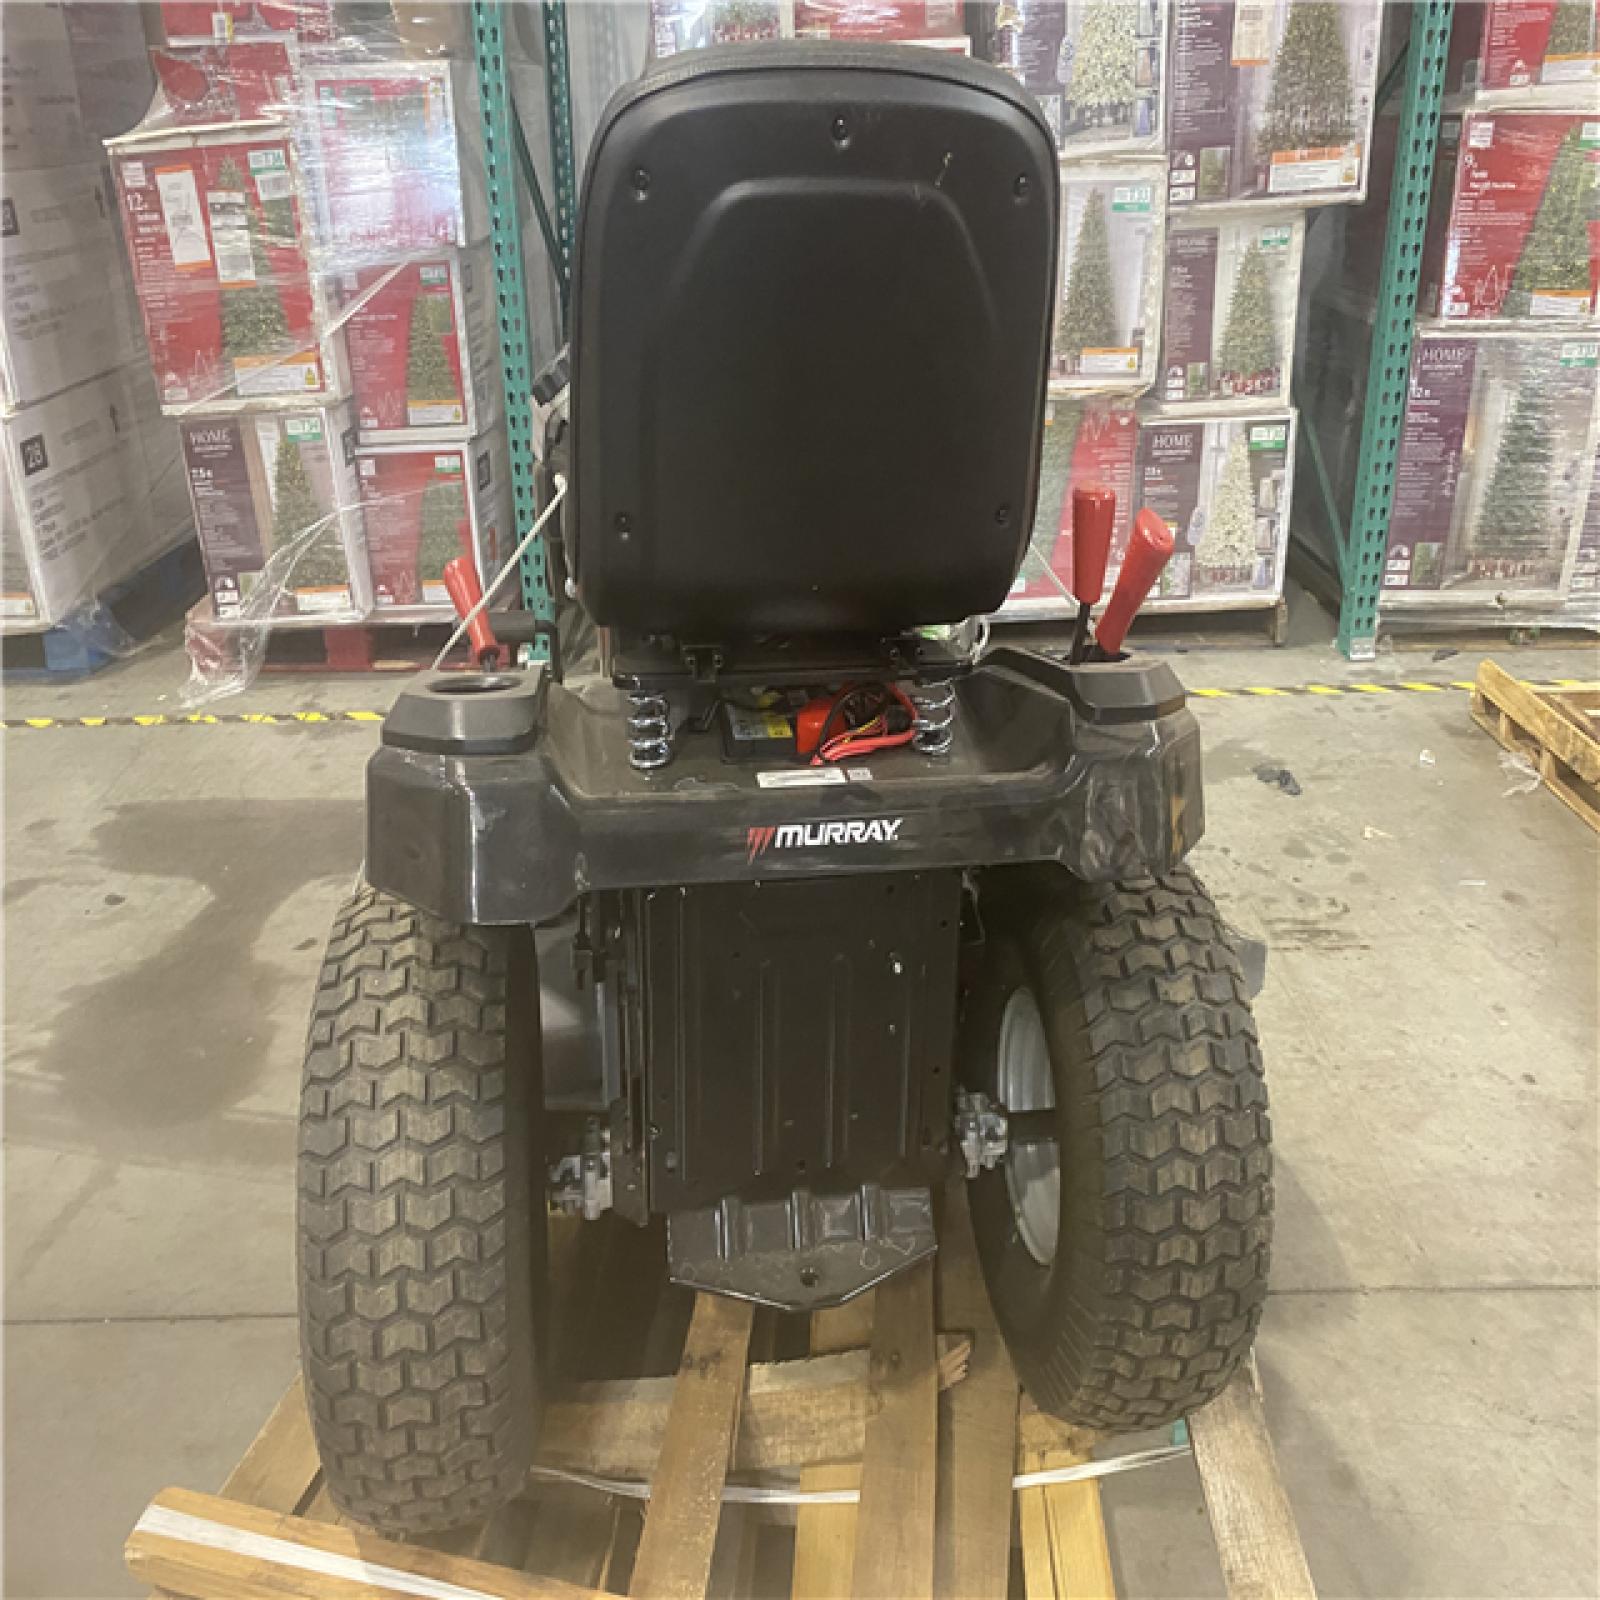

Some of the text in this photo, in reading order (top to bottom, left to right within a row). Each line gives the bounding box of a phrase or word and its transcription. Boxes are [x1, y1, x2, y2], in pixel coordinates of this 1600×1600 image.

[1423, 346, 1467, 362] HOME
[189, 428, 232, 444] HOME
[1152, 434, 1193, 448] HOME
[774, 817, 903, 848] MURRAY
